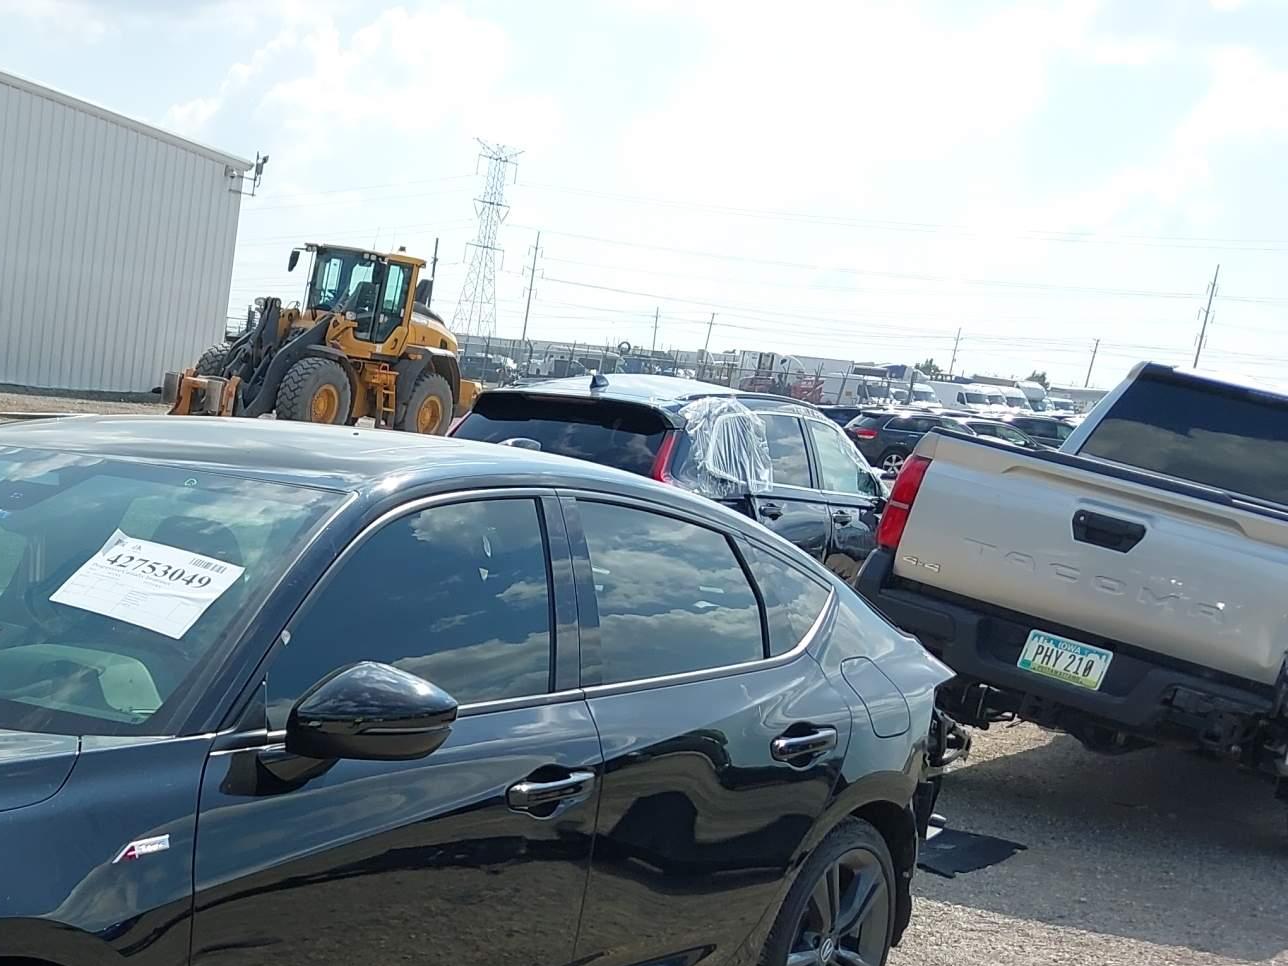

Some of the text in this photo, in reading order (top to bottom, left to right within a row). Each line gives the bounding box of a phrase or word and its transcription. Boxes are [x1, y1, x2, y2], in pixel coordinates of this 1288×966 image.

[106, 553, 212, 589] 42753049
[963, 537, 1226, 626] TACOMA
[1032, 644, 1095, 678] PHY 210
[1057, 640, 1081, 653] IOWA
